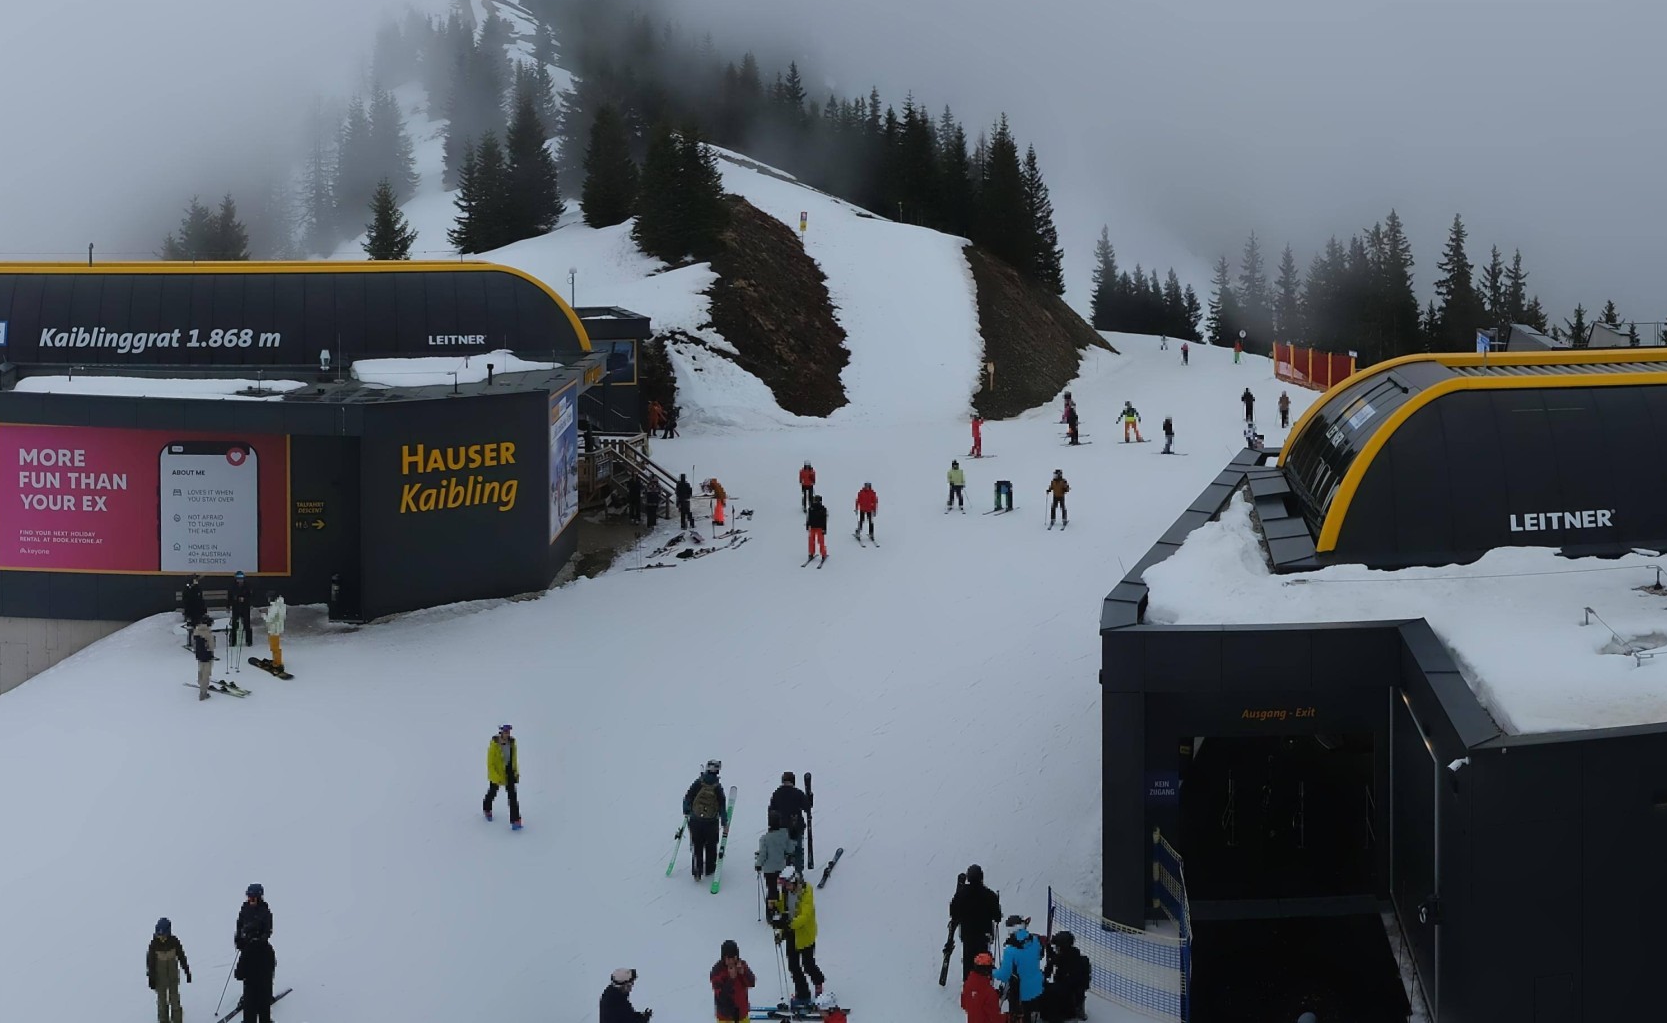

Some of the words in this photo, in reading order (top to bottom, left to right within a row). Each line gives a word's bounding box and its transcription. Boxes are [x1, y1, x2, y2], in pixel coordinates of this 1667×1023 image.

[39, 327, 181, 354] Kaiblinggrat
[186, 328, 252, 348] 1.868
[258, 332, 281, 348] m
[19, 448, 86, 467] MORE
[401, 441, 516, 475] HAUSER
[19, 471, 60, 489] FUN
[67, 472, 127, 490] THAN
[20, 493, 76, 511] YOUR
[82, 495, 108, 512] EX
[400, 475, 518, 514] Kaibling
[27, 547, 50, 555] keyone
[1242, 708, 1287, 721] Ausgang
[1295, 707, 1316, 718] Exit
[1150, 788, 1175, 796] ZUGANG
[1154, 780, 1170, 788] KEIN
